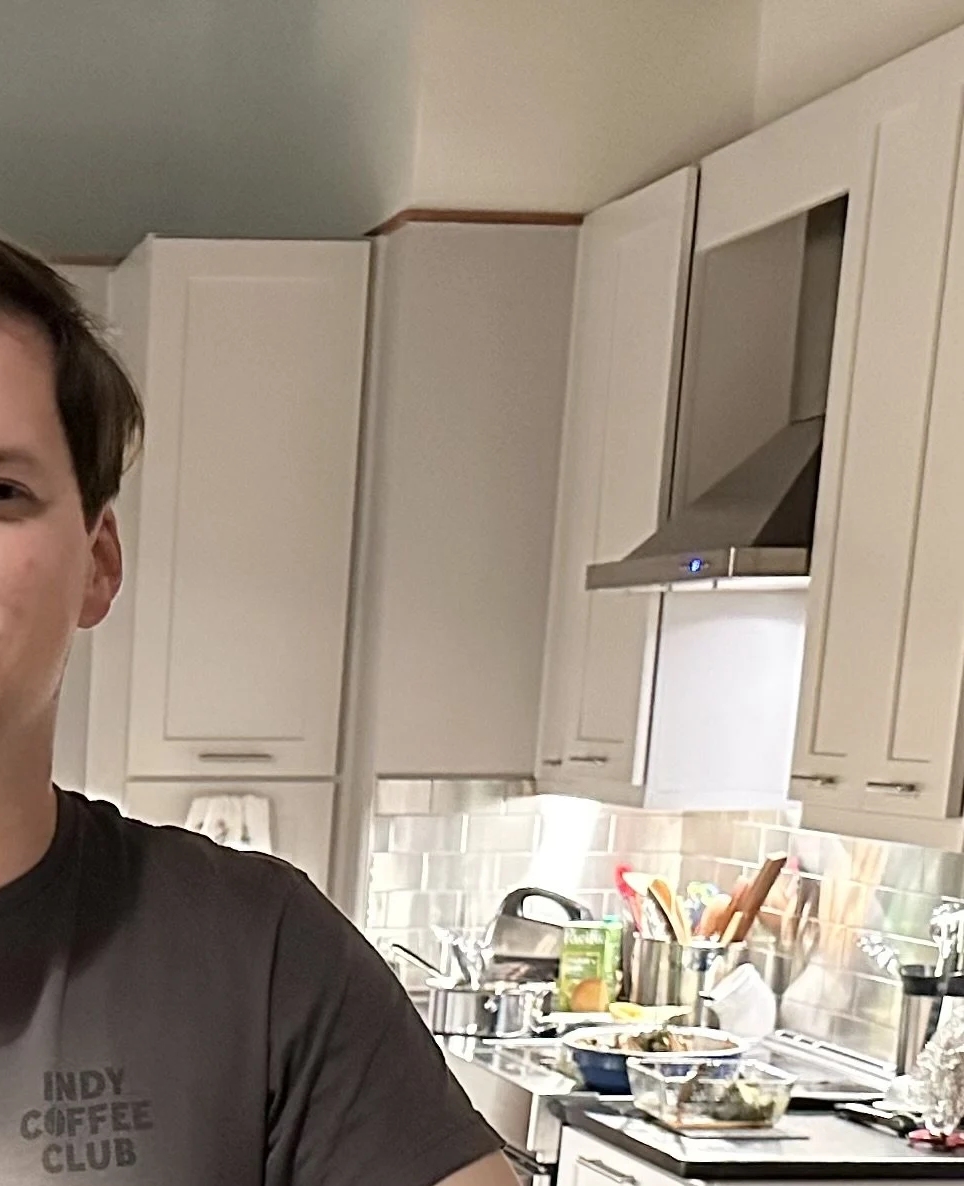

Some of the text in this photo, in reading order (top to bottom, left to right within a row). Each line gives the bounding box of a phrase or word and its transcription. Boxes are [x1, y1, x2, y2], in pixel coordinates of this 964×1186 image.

[43, 1066, 124, 1102] INDY
[20, 1099, 154, 1141] COFFEE
[42, 1137, 137, 1174] CLUB
